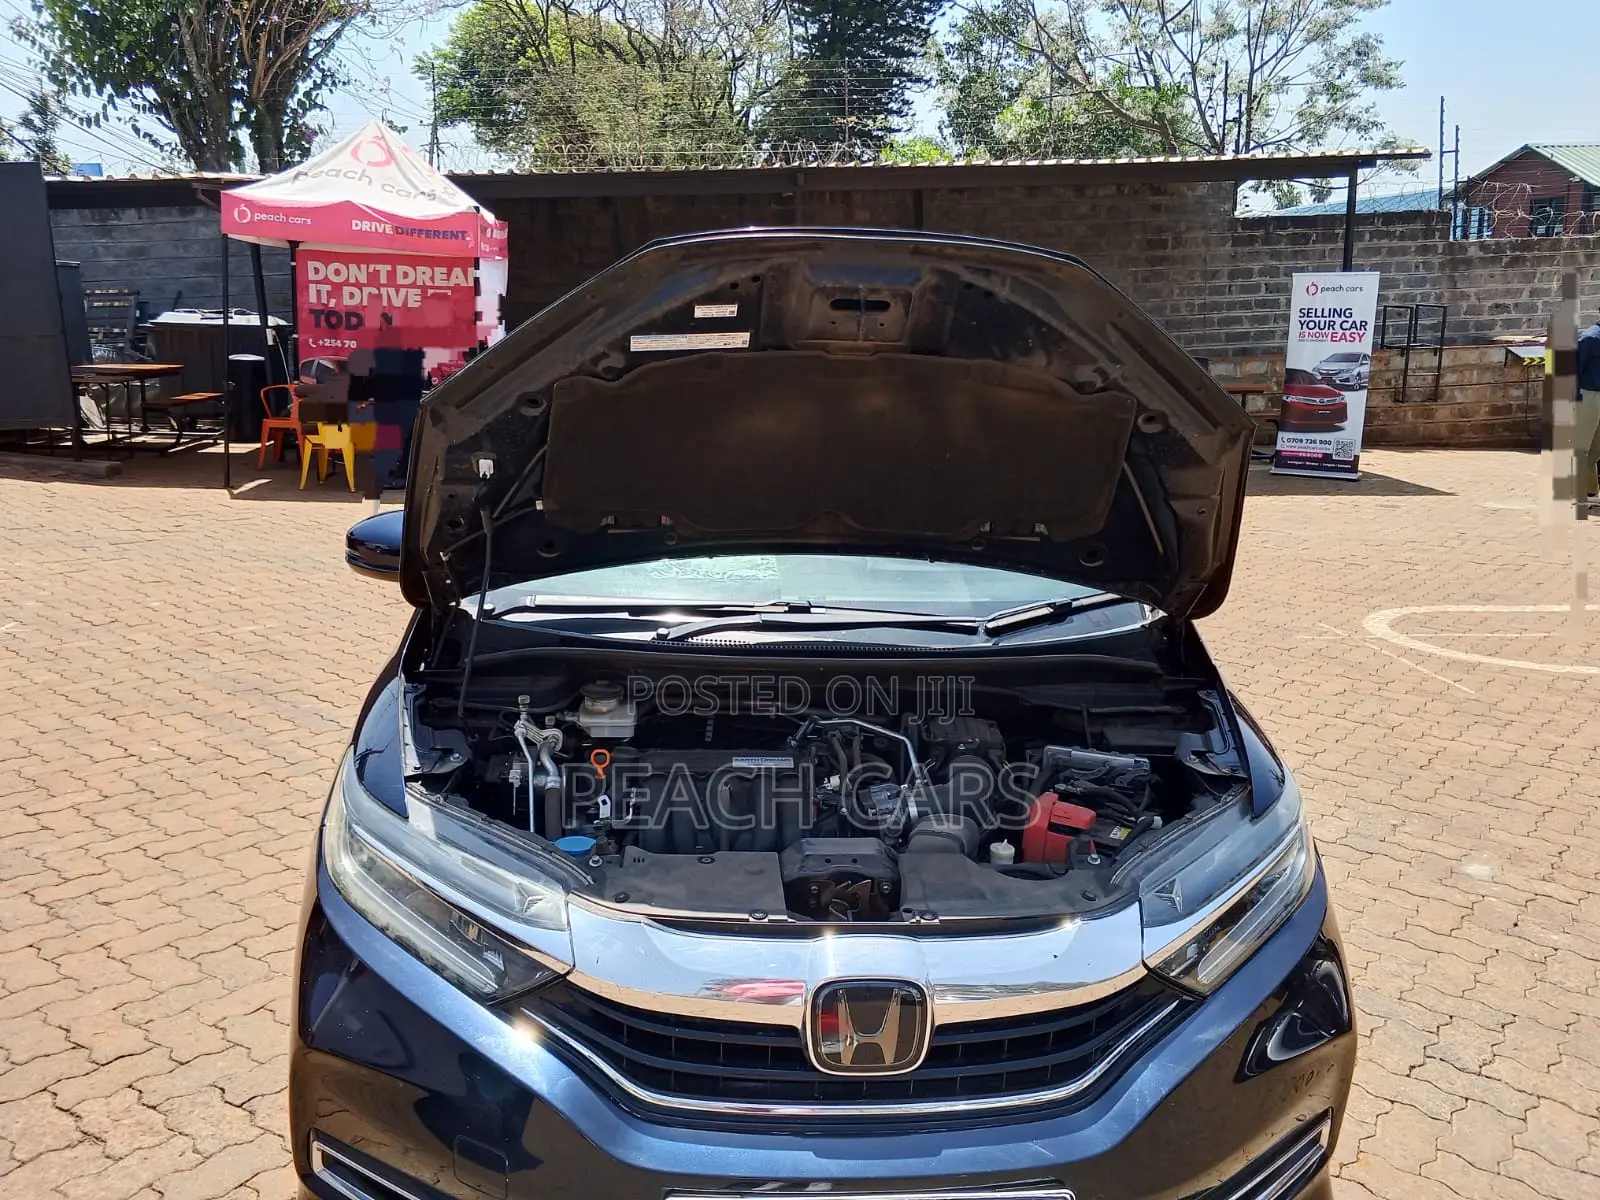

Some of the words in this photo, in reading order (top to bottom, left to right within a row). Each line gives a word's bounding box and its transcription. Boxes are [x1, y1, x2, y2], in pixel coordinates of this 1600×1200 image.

[290, 168, 373, 186] peach
[381, 182, 437, 200] cars
[254, 212, 286, 222] peach
[288, 216, 312, 225] cars
[351, 219, 393, 235] DRIVE
[307, 260, 392, 284] DON'T
[308, 283, 336, 308] IT,
[1320, 284, 1344, 294] peach
[1298, 307, 1353, 319] SELLING
[1298, 320, 1336, 331] YOUR
[1339, 320, 1368, 331] CAR
[1307, 331, 1330, 339] NOW
[1330, 332, 1366, 343] EASY
